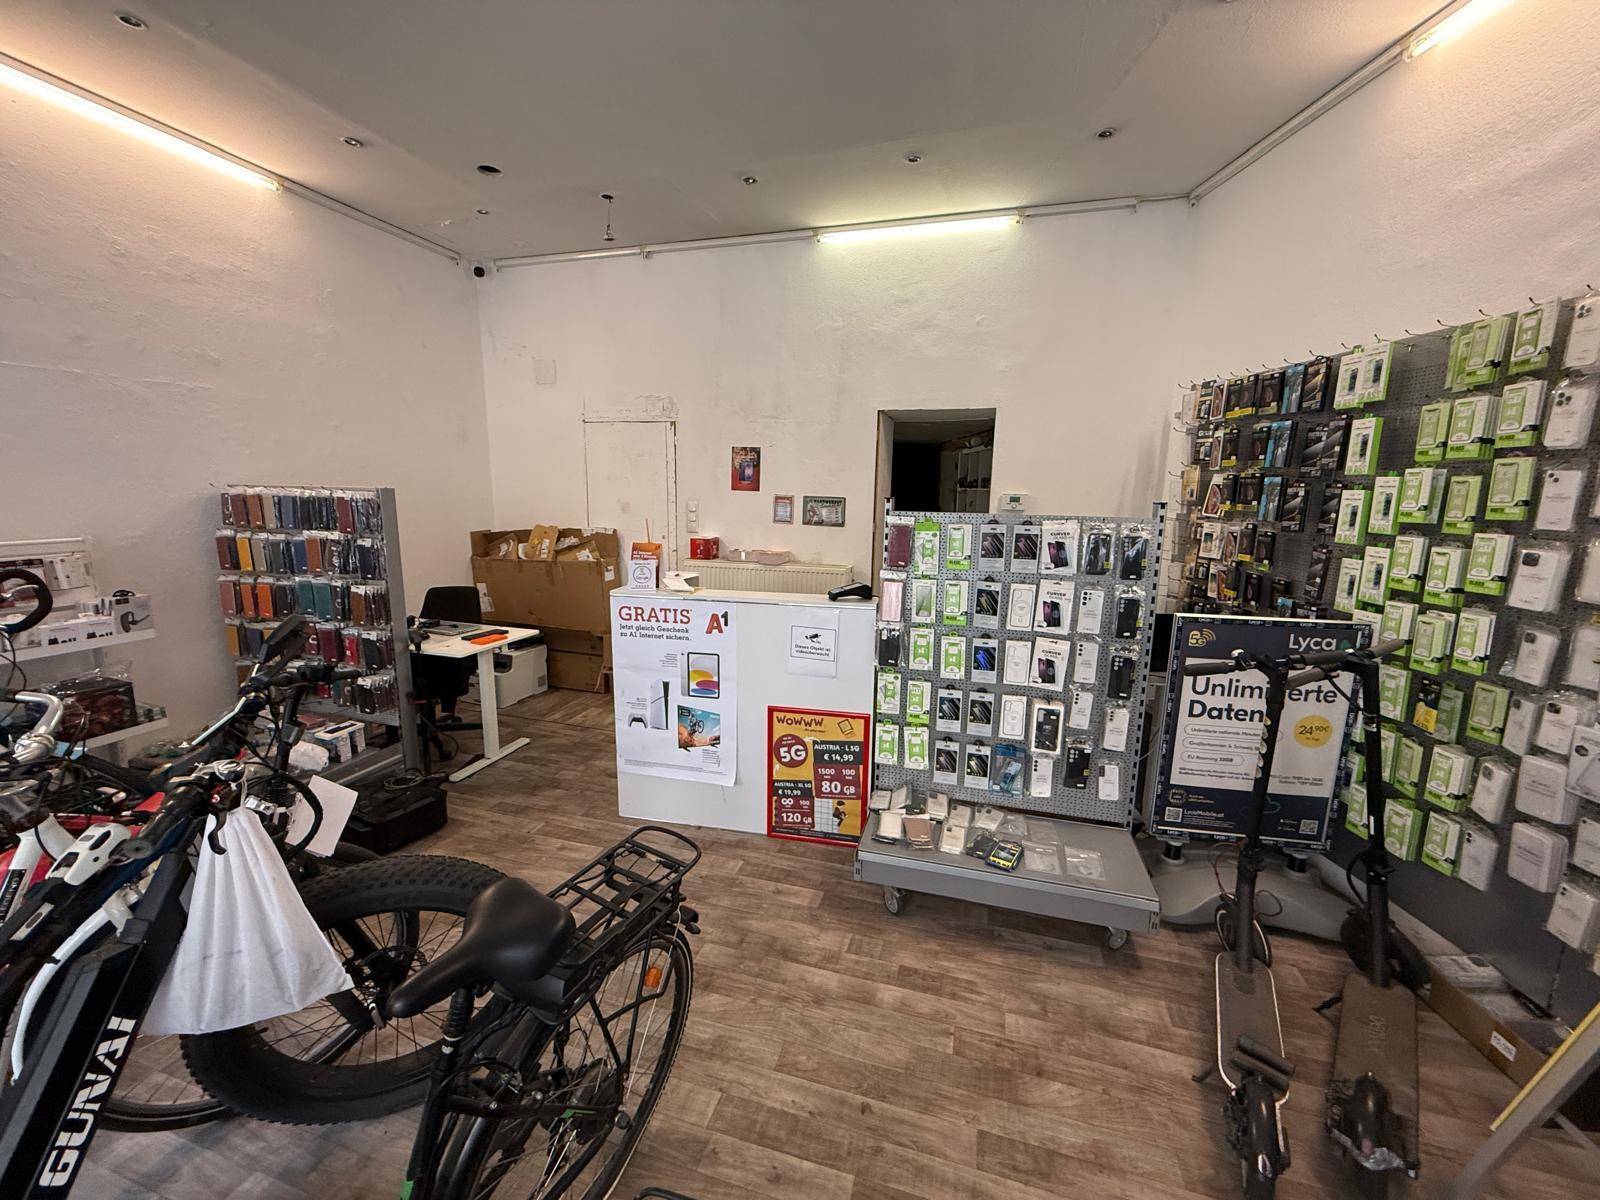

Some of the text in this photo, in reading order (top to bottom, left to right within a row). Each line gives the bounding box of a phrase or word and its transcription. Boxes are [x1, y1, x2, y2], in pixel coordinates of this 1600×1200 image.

[619, 605, 691, 625] GRATIS
[706, 610, 729, 634] A1
[619, 623, 634, 631] Jetzt
[657, 625, 690, 634] Geschenk
[639, 632, 664, 640] Internet
[1189, 632, 1206, 647] 5G
[1289, 633, 1337, 652] Lyca
[1191, 675, 1338, 704] Unlimierte
[1187, 699, 1265, 723] Daten
[779, 744, 806, 762] 5G
[823, 753, 854, 762] € 14,99
[821, 781, 842, 794] 80
[781, 812, 801, 823] 120
[39, 1015, 137, 1187] GUNAI
